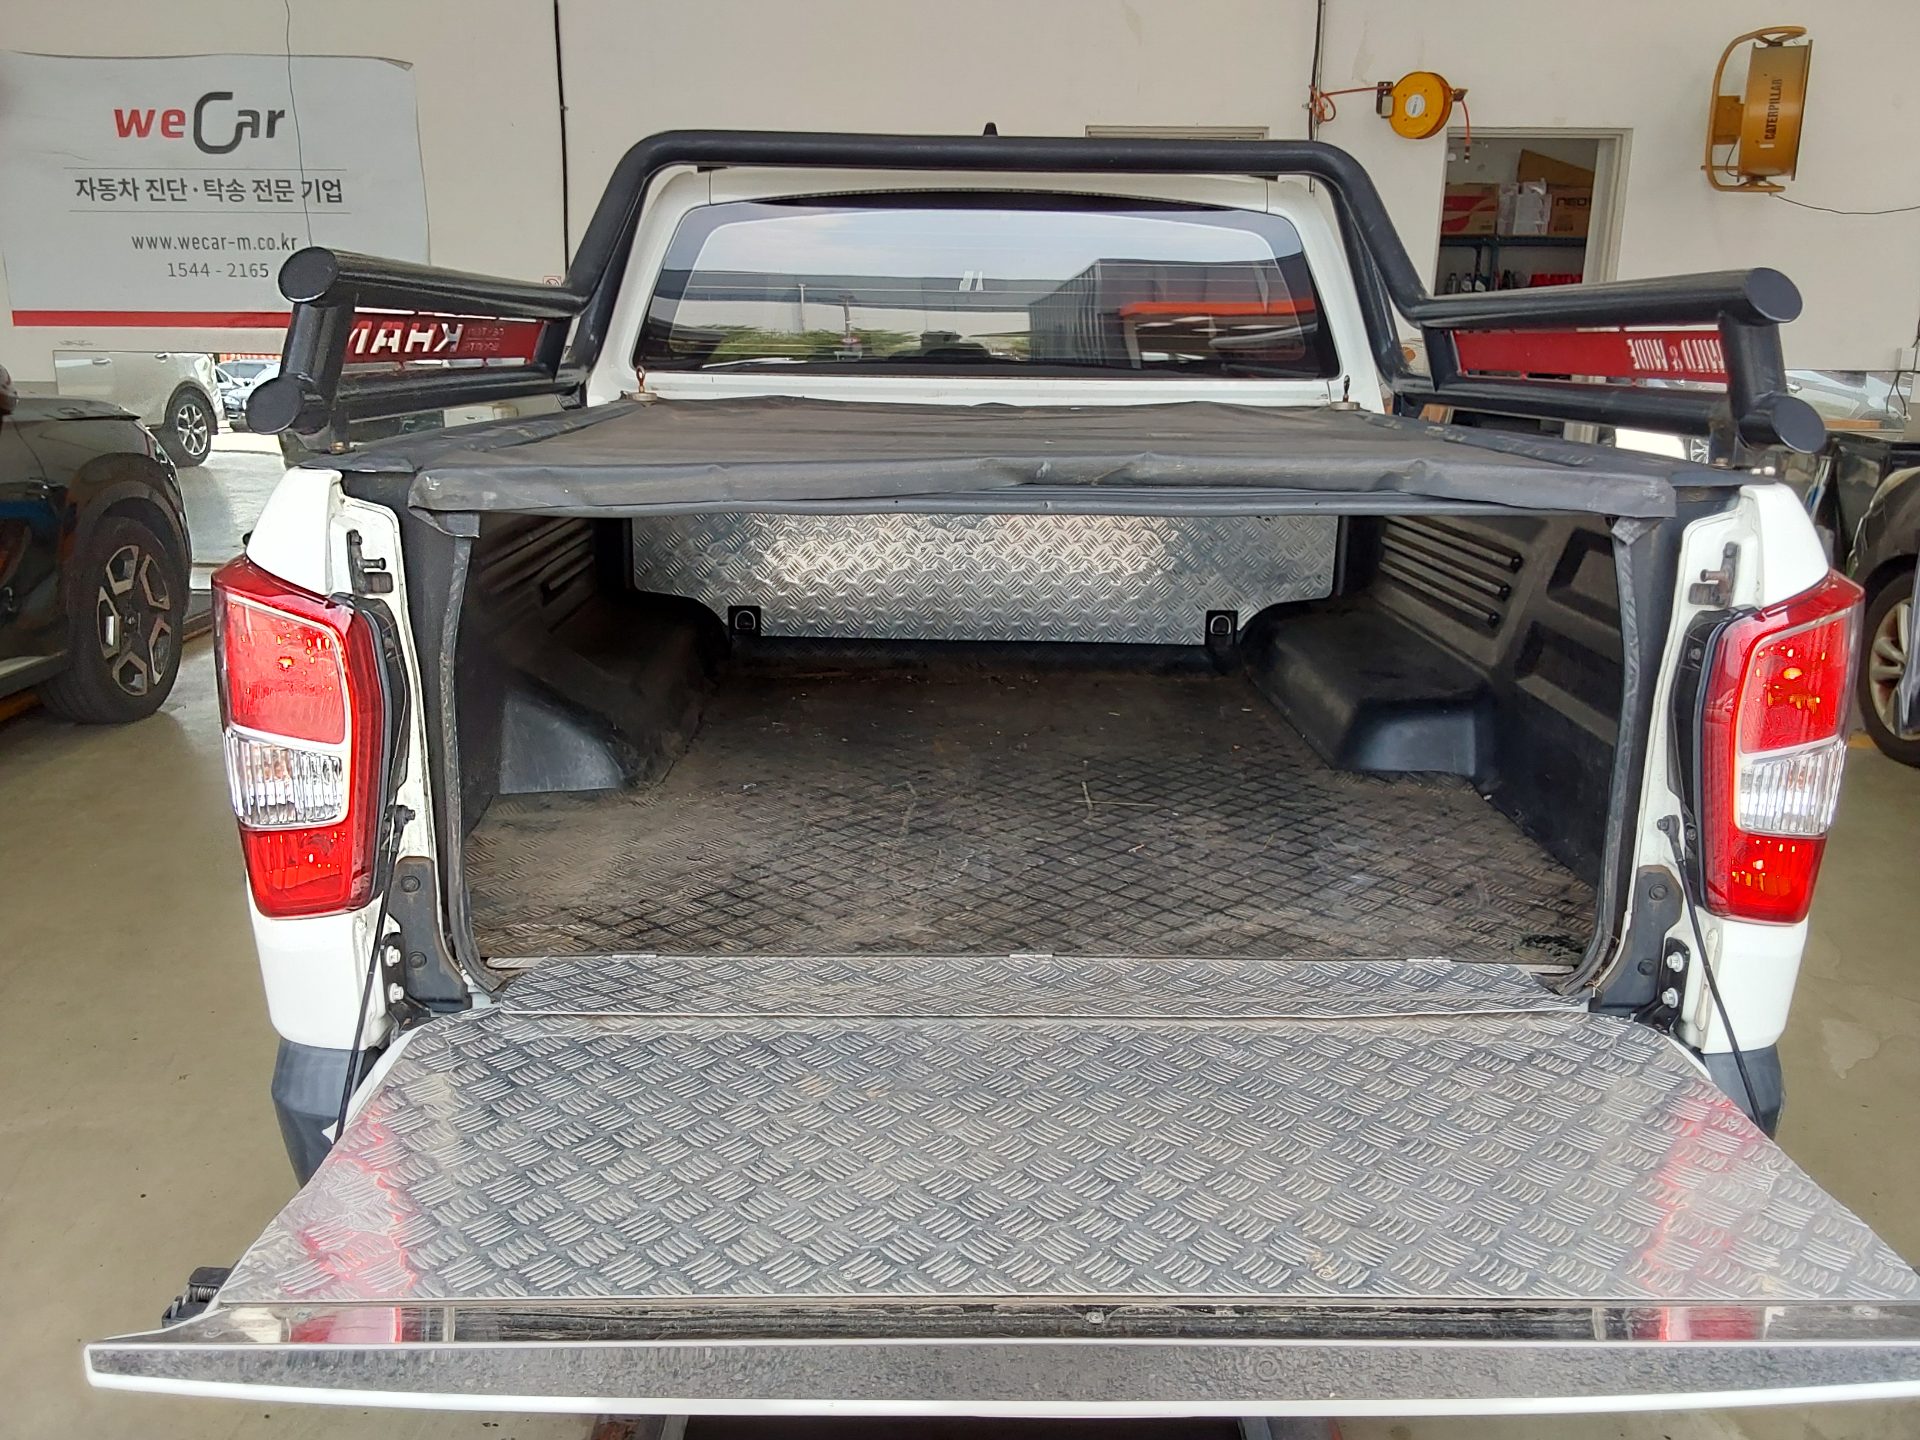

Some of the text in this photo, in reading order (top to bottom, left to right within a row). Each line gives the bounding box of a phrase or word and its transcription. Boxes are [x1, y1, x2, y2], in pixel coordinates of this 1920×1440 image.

[1764, 78, 1782, 140] CATERPILLAR
[74, 178, 140, 202] 자동차
[252, 178, 296, 203] 전문
[302, 178, 343, 203] 기업
[131, 233, 298, 252] www.wecar-m.co.kr
